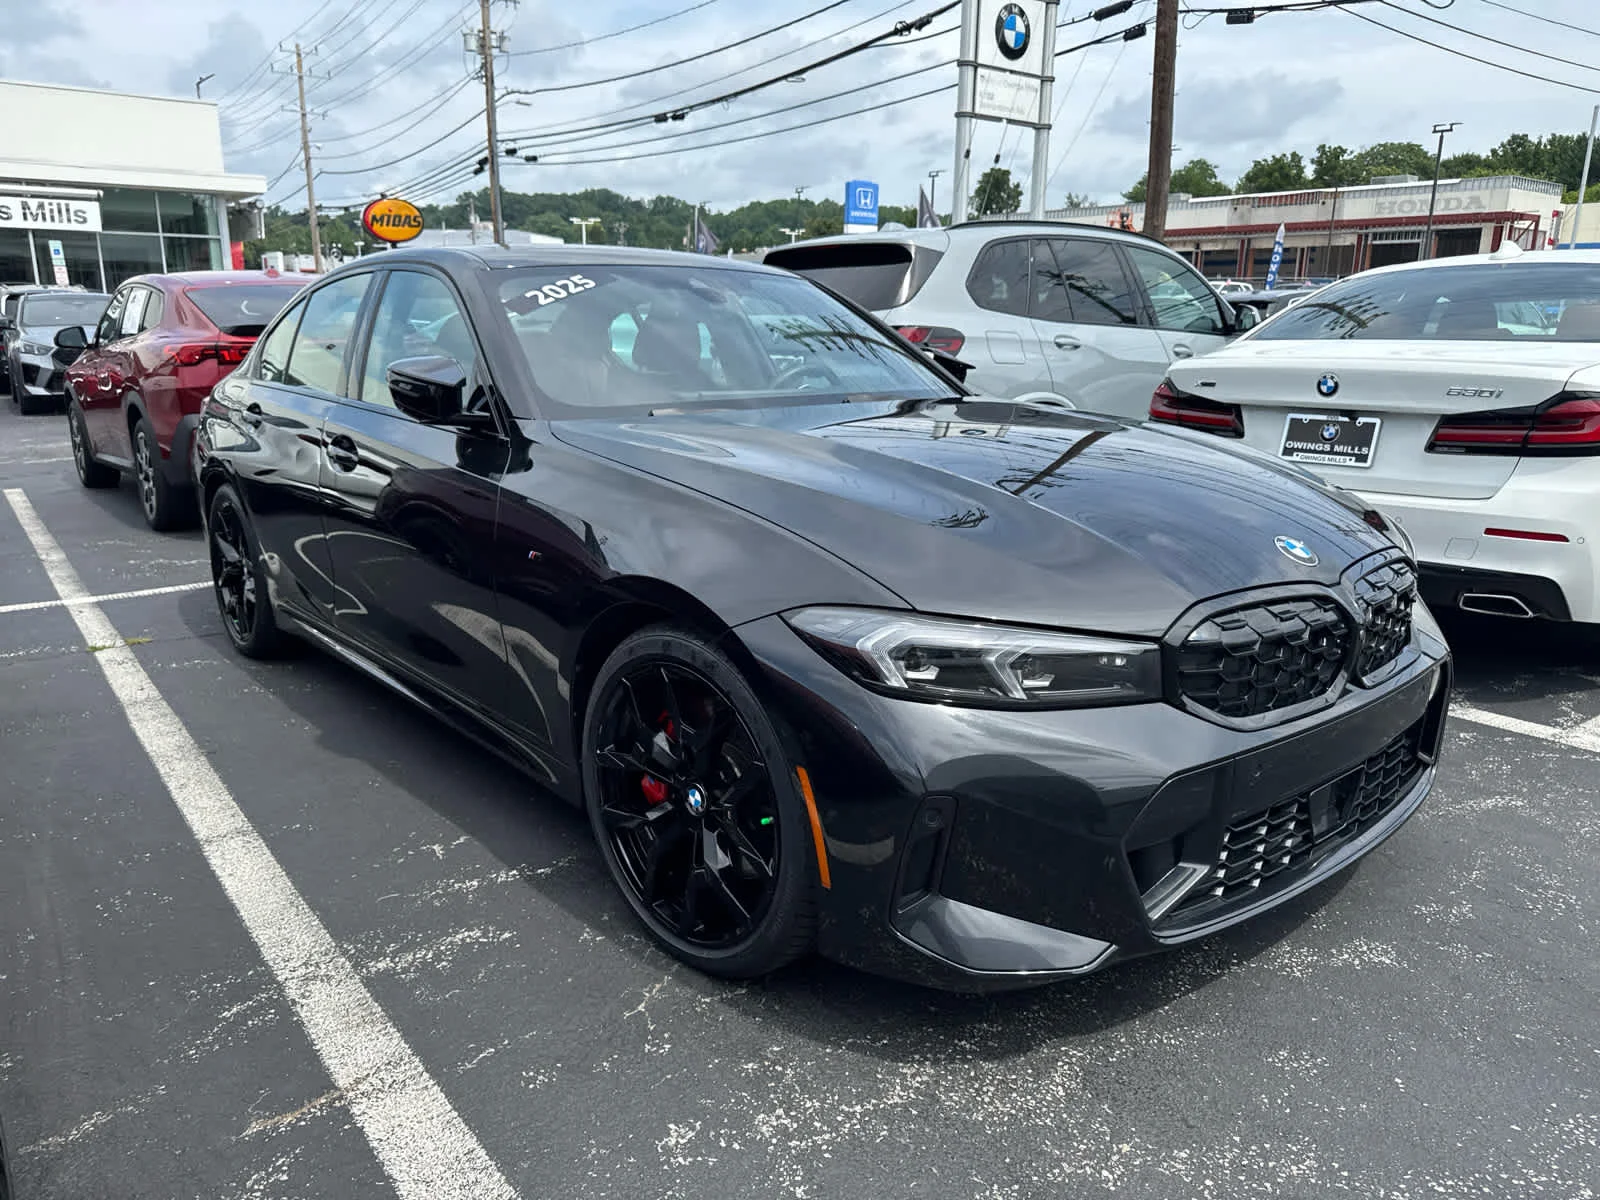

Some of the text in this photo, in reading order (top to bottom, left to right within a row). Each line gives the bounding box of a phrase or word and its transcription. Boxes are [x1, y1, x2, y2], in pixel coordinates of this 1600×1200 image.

[21, 200, 88, 224] Mills
[1376, 196, 1486, 214] HONDA
[525, 274, 596, 305] 2025
[1285, 441, 1369, 455] OWINGS MILLS
